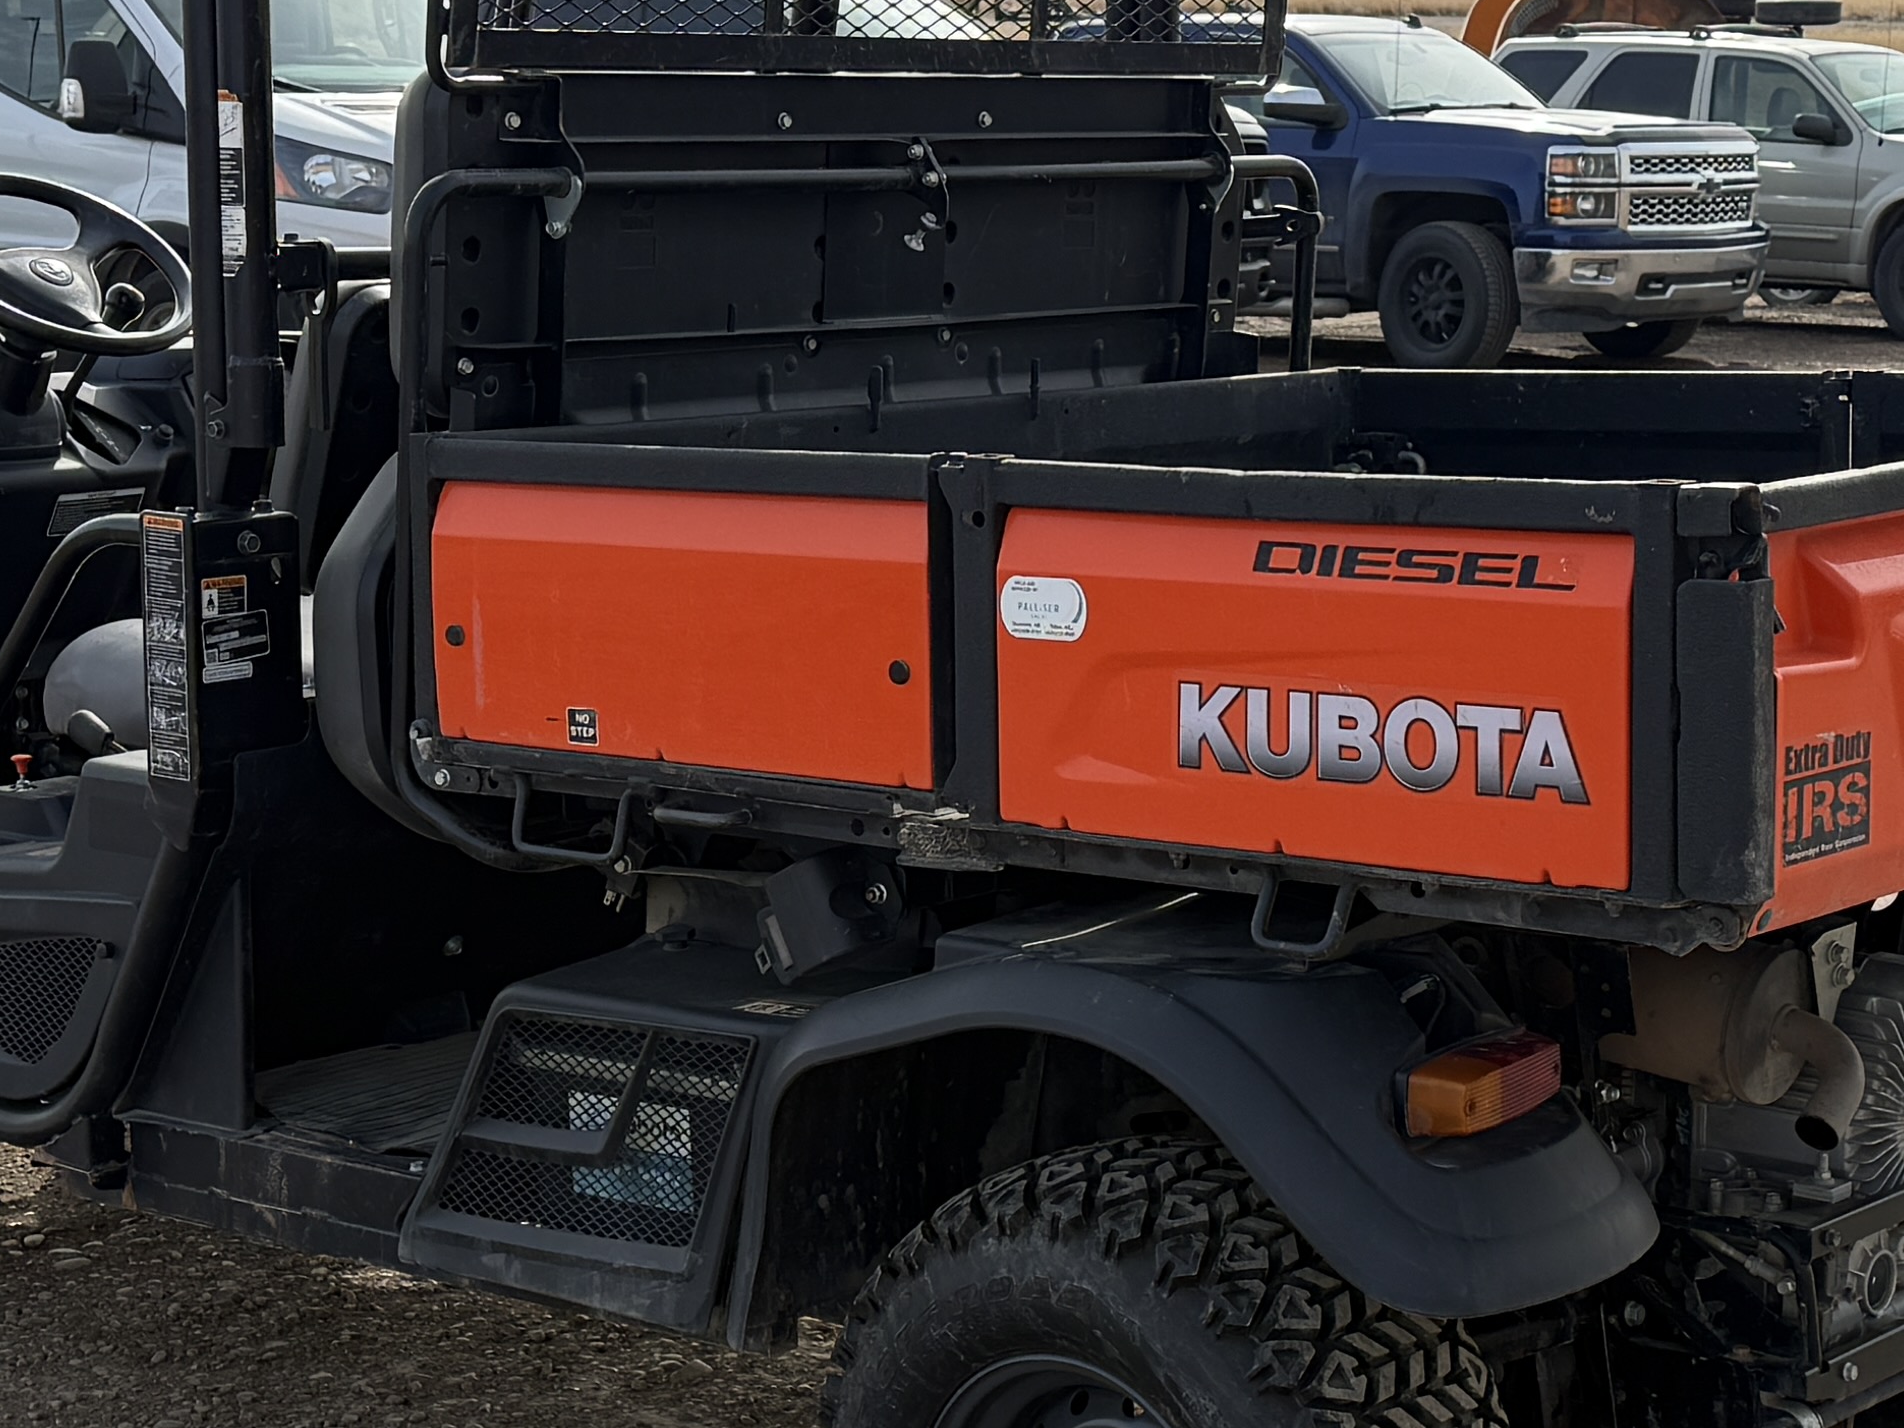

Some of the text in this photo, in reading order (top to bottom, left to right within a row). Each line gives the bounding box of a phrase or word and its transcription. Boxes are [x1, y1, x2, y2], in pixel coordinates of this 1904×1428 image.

[1252, 540, 1577, 592] DIESEL
[575, 713, 590, 724] NO
[1178, 680, 1591, 806] KUBOTA
[1784, 730, 1871, 776] Extra Duty
[1785, 771, 1869, 844] IRS
